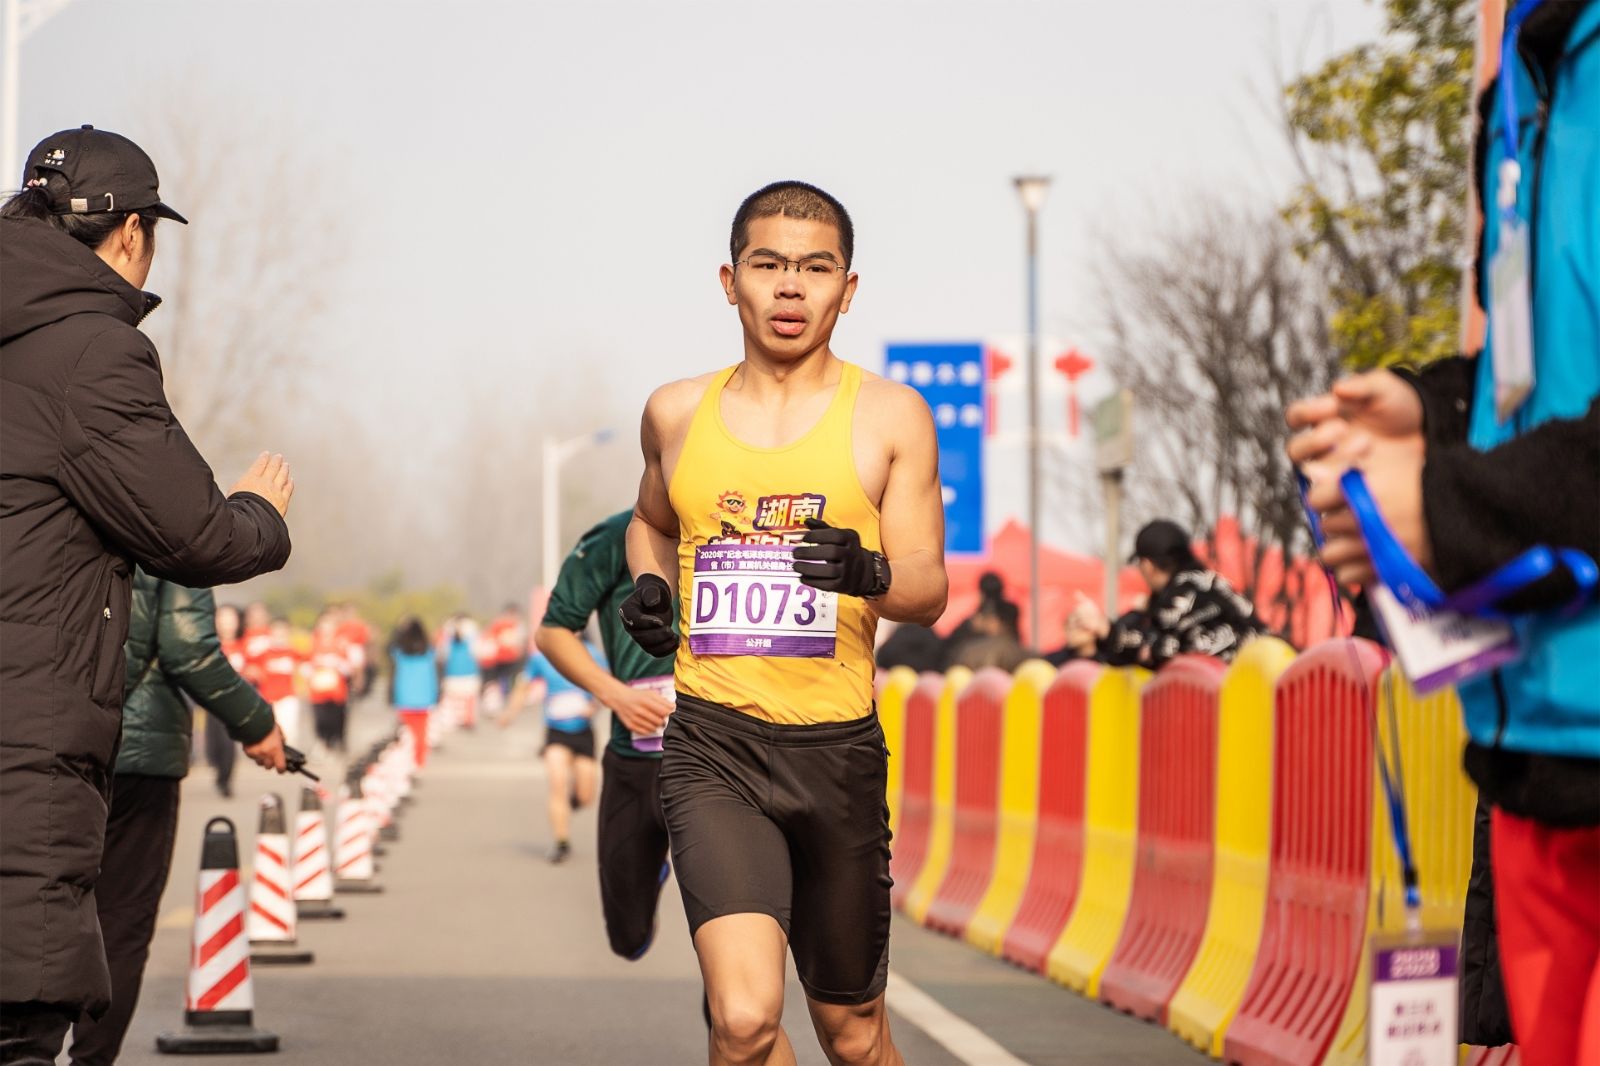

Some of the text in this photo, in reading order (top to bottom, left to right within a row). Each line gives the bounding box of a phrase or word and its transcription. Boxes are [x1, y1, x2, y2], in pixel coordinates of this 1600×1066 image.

[757, 497, 821, 527] 湖南
[696, 581, 817, 626] D1073
[745, 638, 772, 648] 公开组
